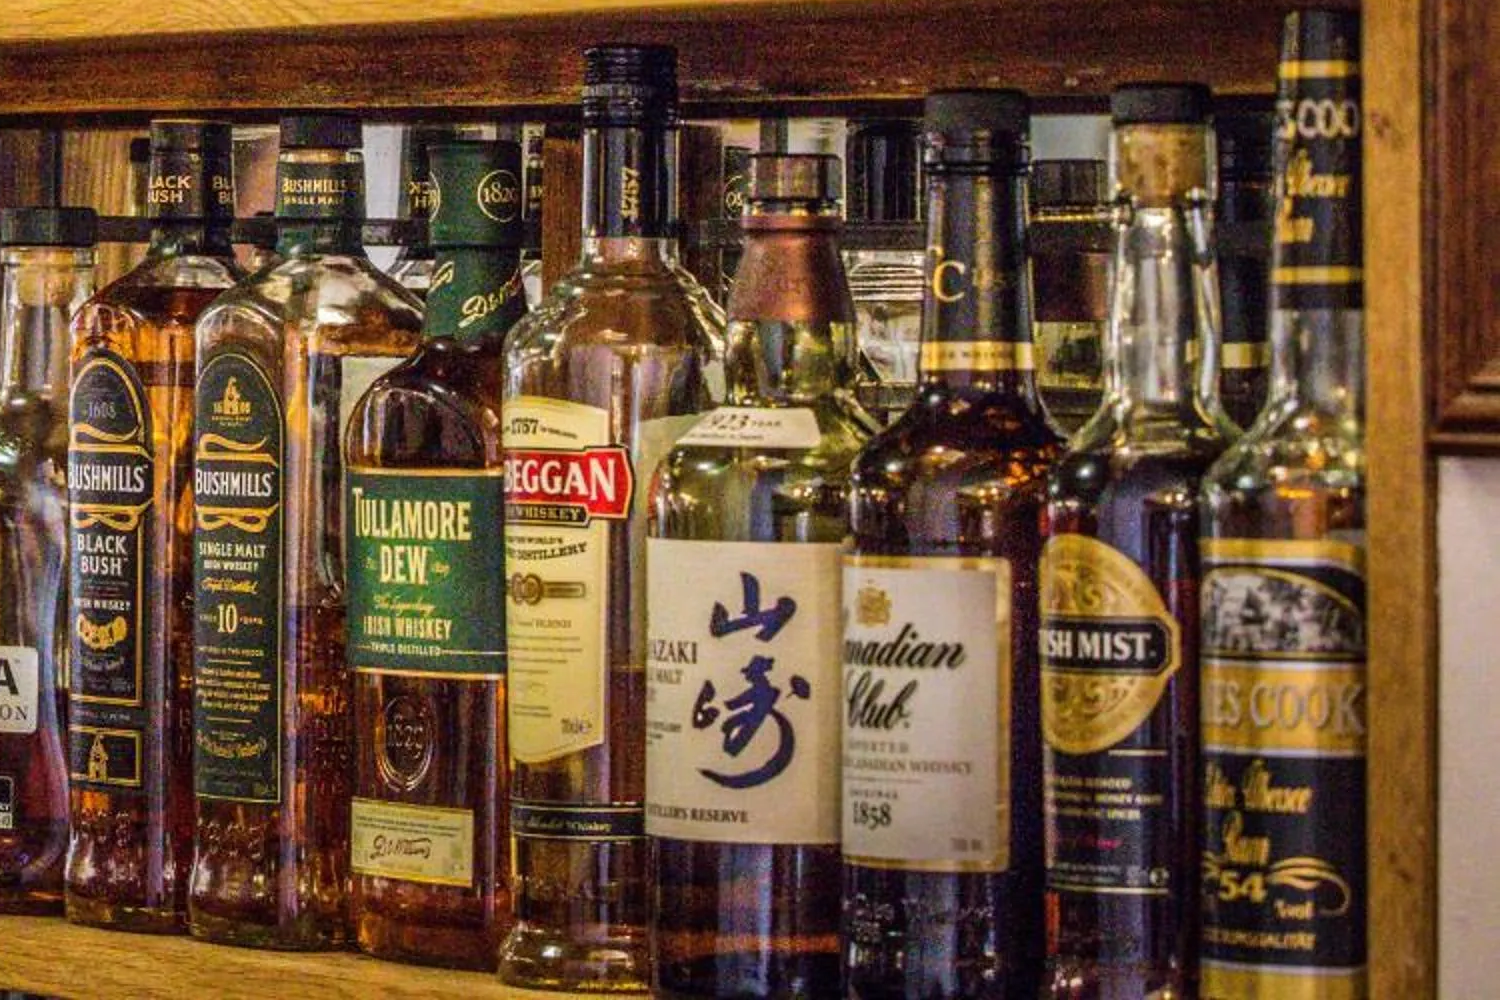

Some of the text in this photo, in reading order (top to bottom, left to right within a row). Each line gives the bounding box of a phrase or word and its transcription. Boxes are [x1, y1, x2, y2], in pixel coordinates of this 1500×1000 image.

[195, 468, 274, 497] BUSHMILLS
[353, 488, 473, 542] TULLAMORE
[78, 533, 128, 555] BLACK
[199, 541, 267, 560] SINGLE MALT
[80, 557, 124, 577] BUSH
[217, 603, 238, 635] 10
[396, 617, 452, 641] WHISKEY
[690, 807, 749, 824] RESERVE
[853, 801, 893, 830] 1858
